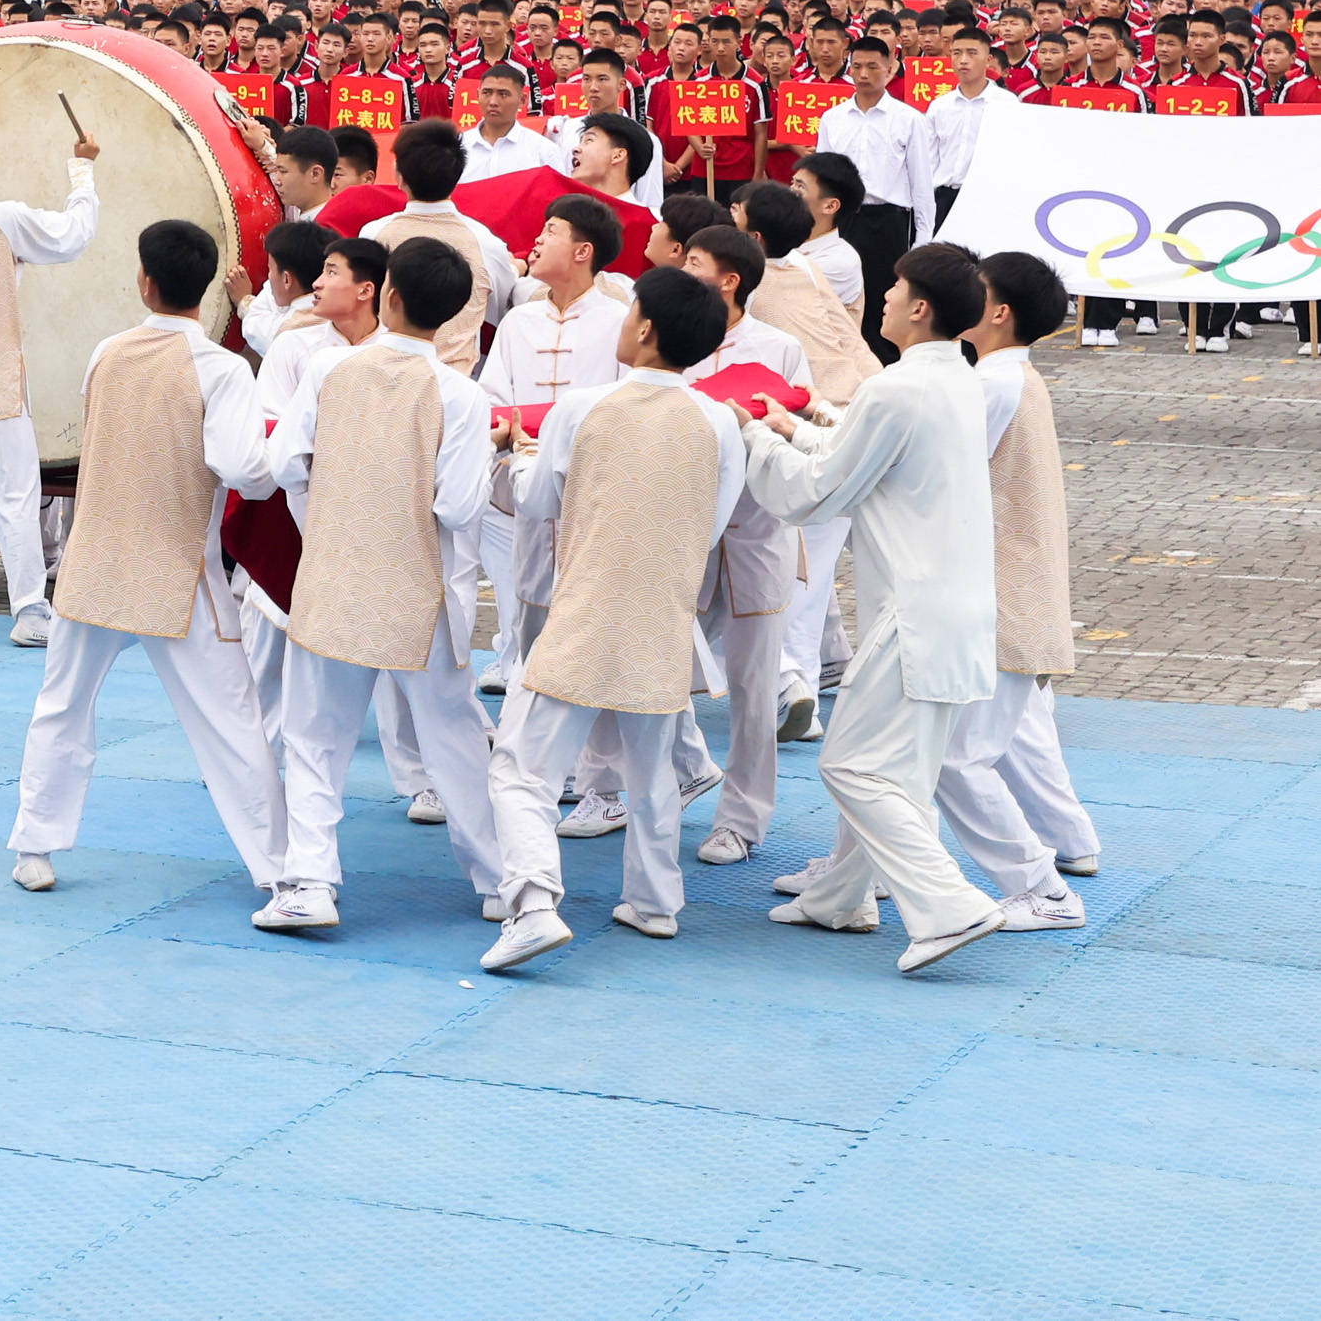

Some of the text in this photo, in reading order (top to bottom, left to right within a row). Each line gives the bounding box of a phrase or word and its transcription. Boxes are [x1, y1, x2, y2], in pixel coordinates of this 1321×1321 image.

[912, 59, 955, 76] 1-2-
[229, 85, 267, 100] -9-1
[338, 87, 396, 105] 3-8-9
[533, 86, 542, 104] GOU
[675, 83, 740, 99] 1-2-16
[912, 82, 953, 102] 代表
[559, 94, 589, 110] 1-2
[1166, 97, 1229, 115] 1-2-2
[336, 108, 395, 130] 代表队
[677, 105, 740, 125] 代表队
[784, 114, 820, 135] 代表
